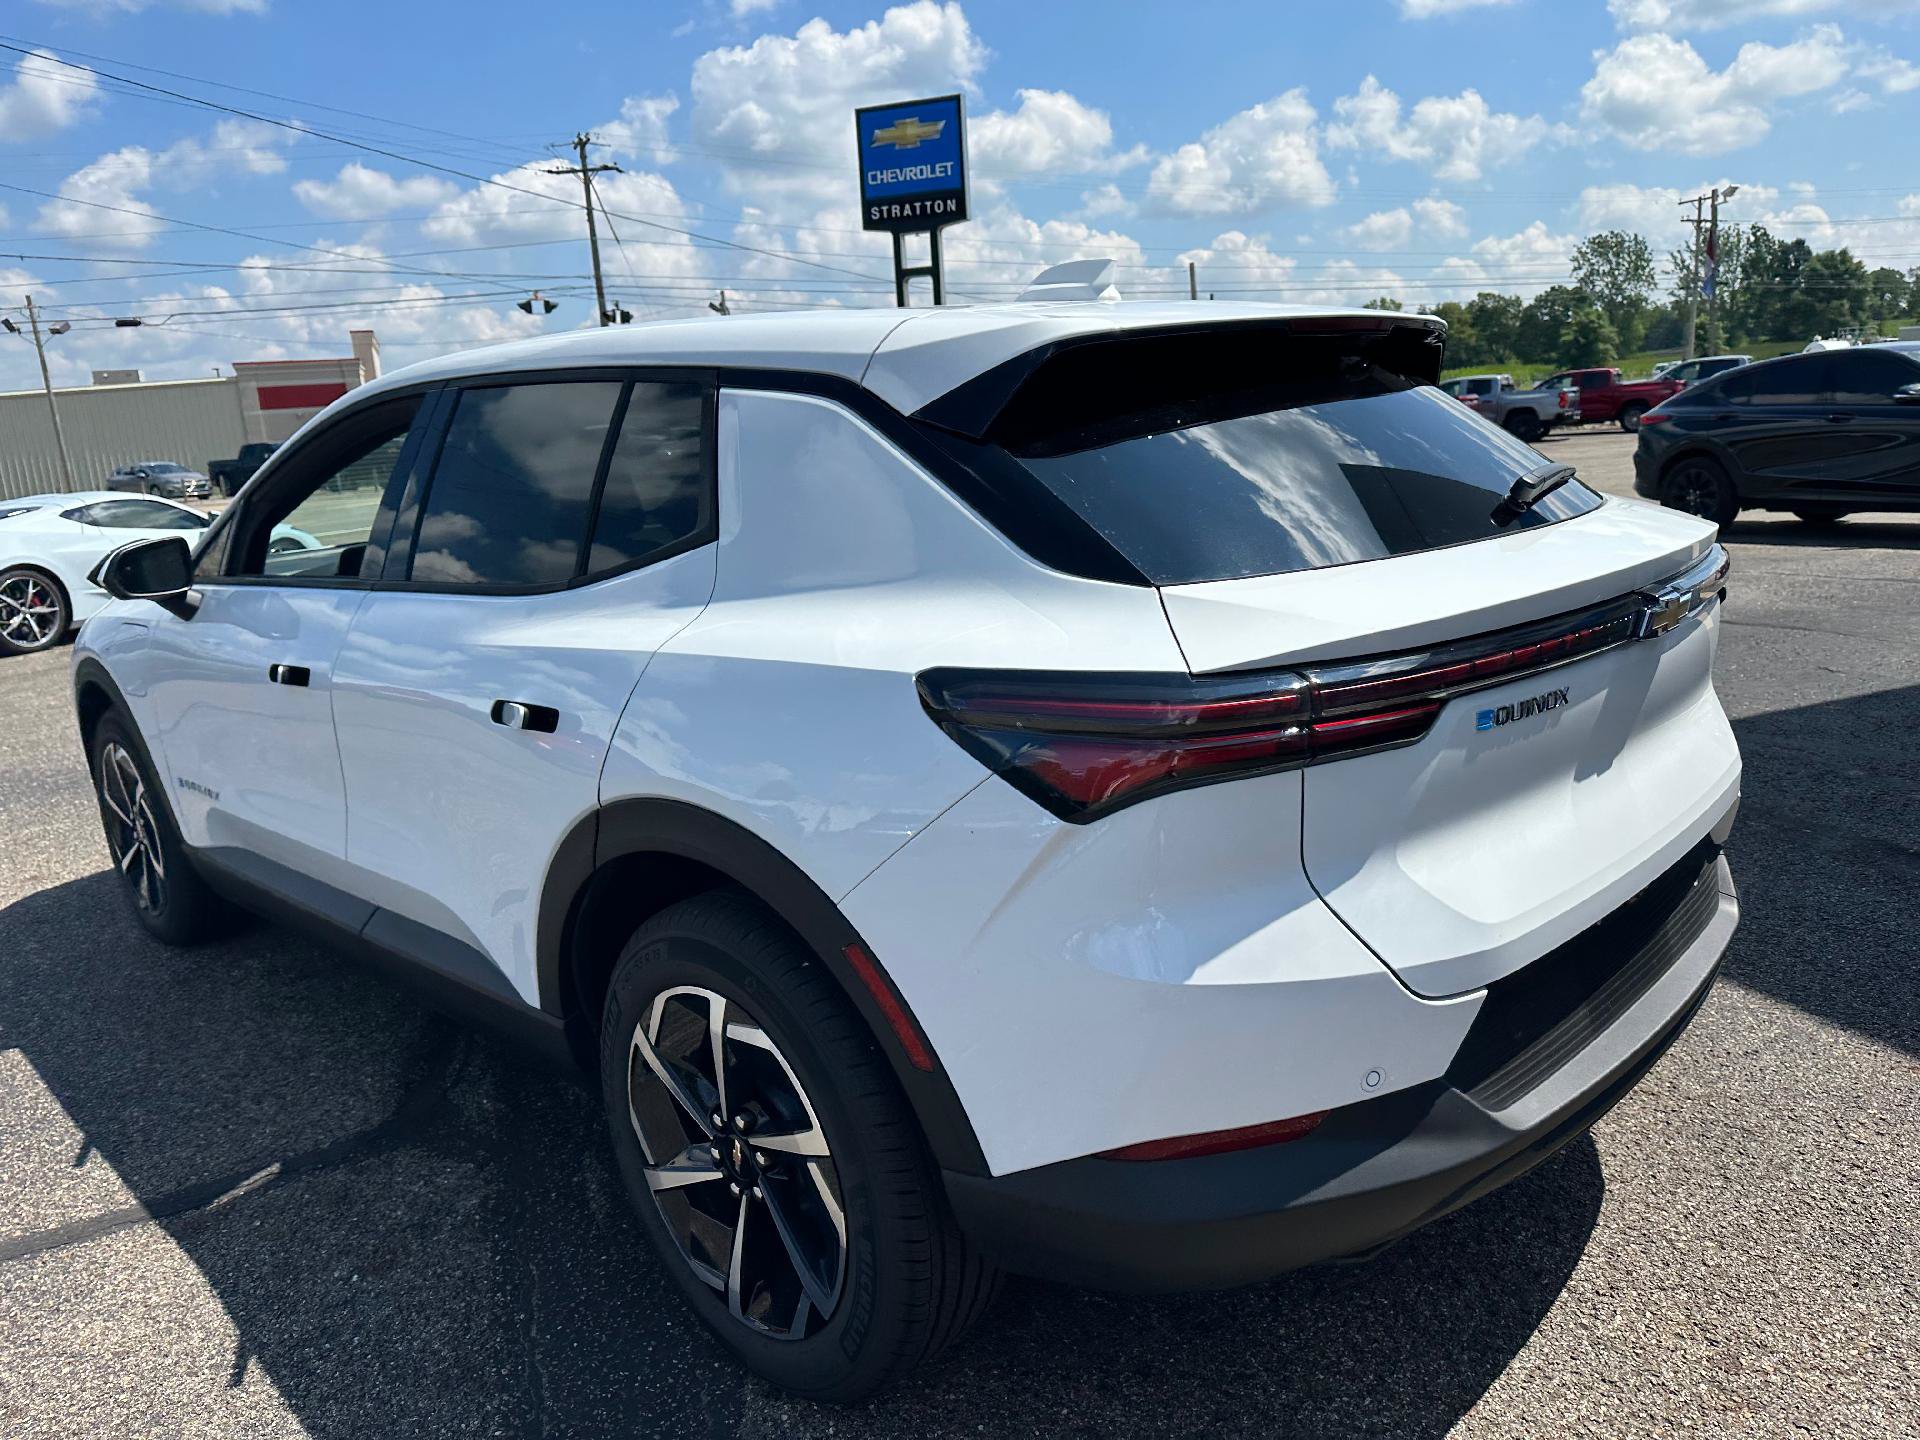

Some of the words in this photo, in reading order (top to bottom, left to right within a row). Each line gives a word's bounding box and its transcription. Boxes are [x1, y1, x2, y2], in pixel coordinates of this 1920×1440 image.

[867, 161, 954, 185] CHEVROLET
[870, 198, 957, 220] STRATTON
[1475, 686, 1570, 730] EQUINOX
